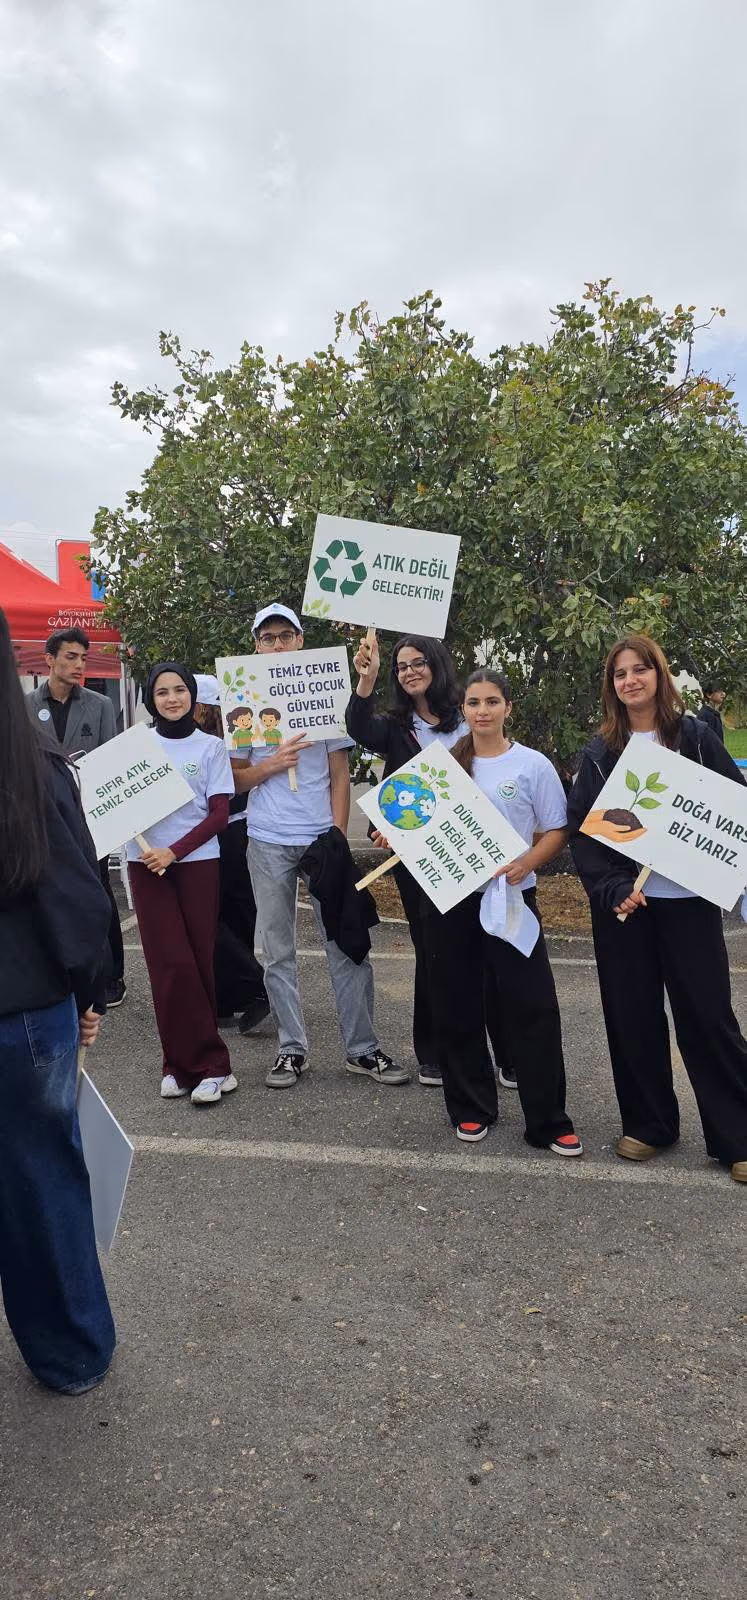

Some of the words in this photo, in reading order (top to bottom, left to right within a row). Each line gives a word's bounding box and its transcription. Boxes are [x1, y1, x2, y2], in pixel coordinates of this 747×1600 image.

[372, 553, 406, 573] ATIK
[408, 557, 450, 580] DEĞİL
[372, 579, 444, 602] GELECEKTİR!
[268, 663, 303, 679] TEMİZ
[305, 661, 341, 678] ÇEVRE
[269, 681, 306, 697] GÜÇLÜ
[308, 678, 345, 696] ÇOCUK
[287, 696, 334, 713] GÜVENLİ
[288, 714, 340, 729] GELECEK.
[88, 794, 124, 819] TEMİZ
[123, 763, 173, 797] GELECEK
[95, 776, 125, 799] SIFIR
[126, 759, 151, 781] ATIK
[672, 794, 712, 824] DOĞA
[439, 820, 467, 857] DEĞİL,
[465, 852, 486, 874] BİZ
[453, 803, 485, 841] DÜNYA
[480, 838, 506, 864] BİZE
[668, 821, 694, 843] BİZ
[695, 833, 738, 868] VARIZ.
[416, 857, 443, 889] AİTİZ.
[425, 835, 466, 884] DÜNYAYA
